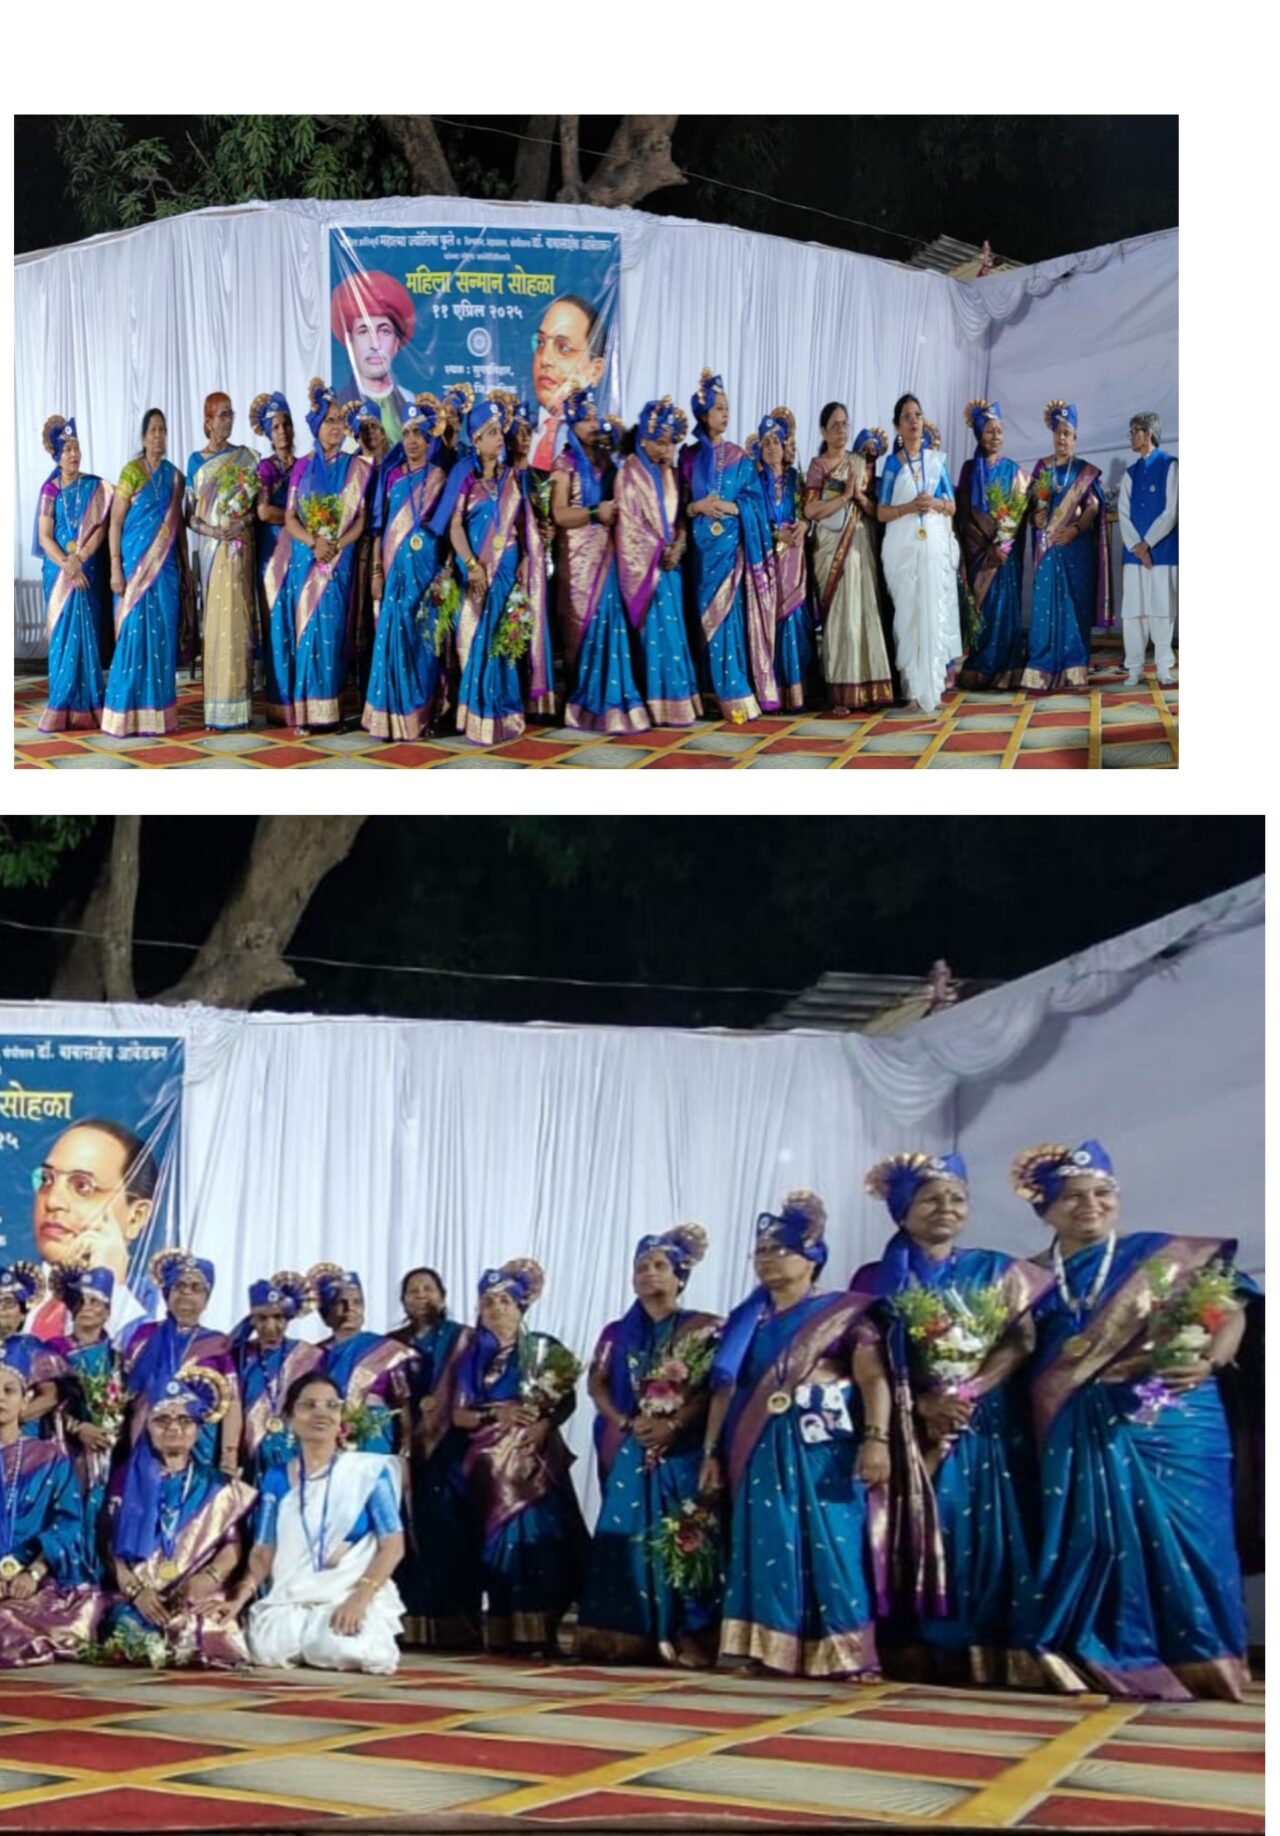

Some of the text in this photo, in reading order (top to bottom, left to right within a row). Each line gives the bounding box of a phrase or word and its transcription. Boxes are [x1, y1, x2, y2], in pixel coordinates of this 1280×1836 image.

[405, 264, 556, 297] महिला सन्मान सोहळा
[432, 299, 524, 321] ११ एप्रिल २०२५
